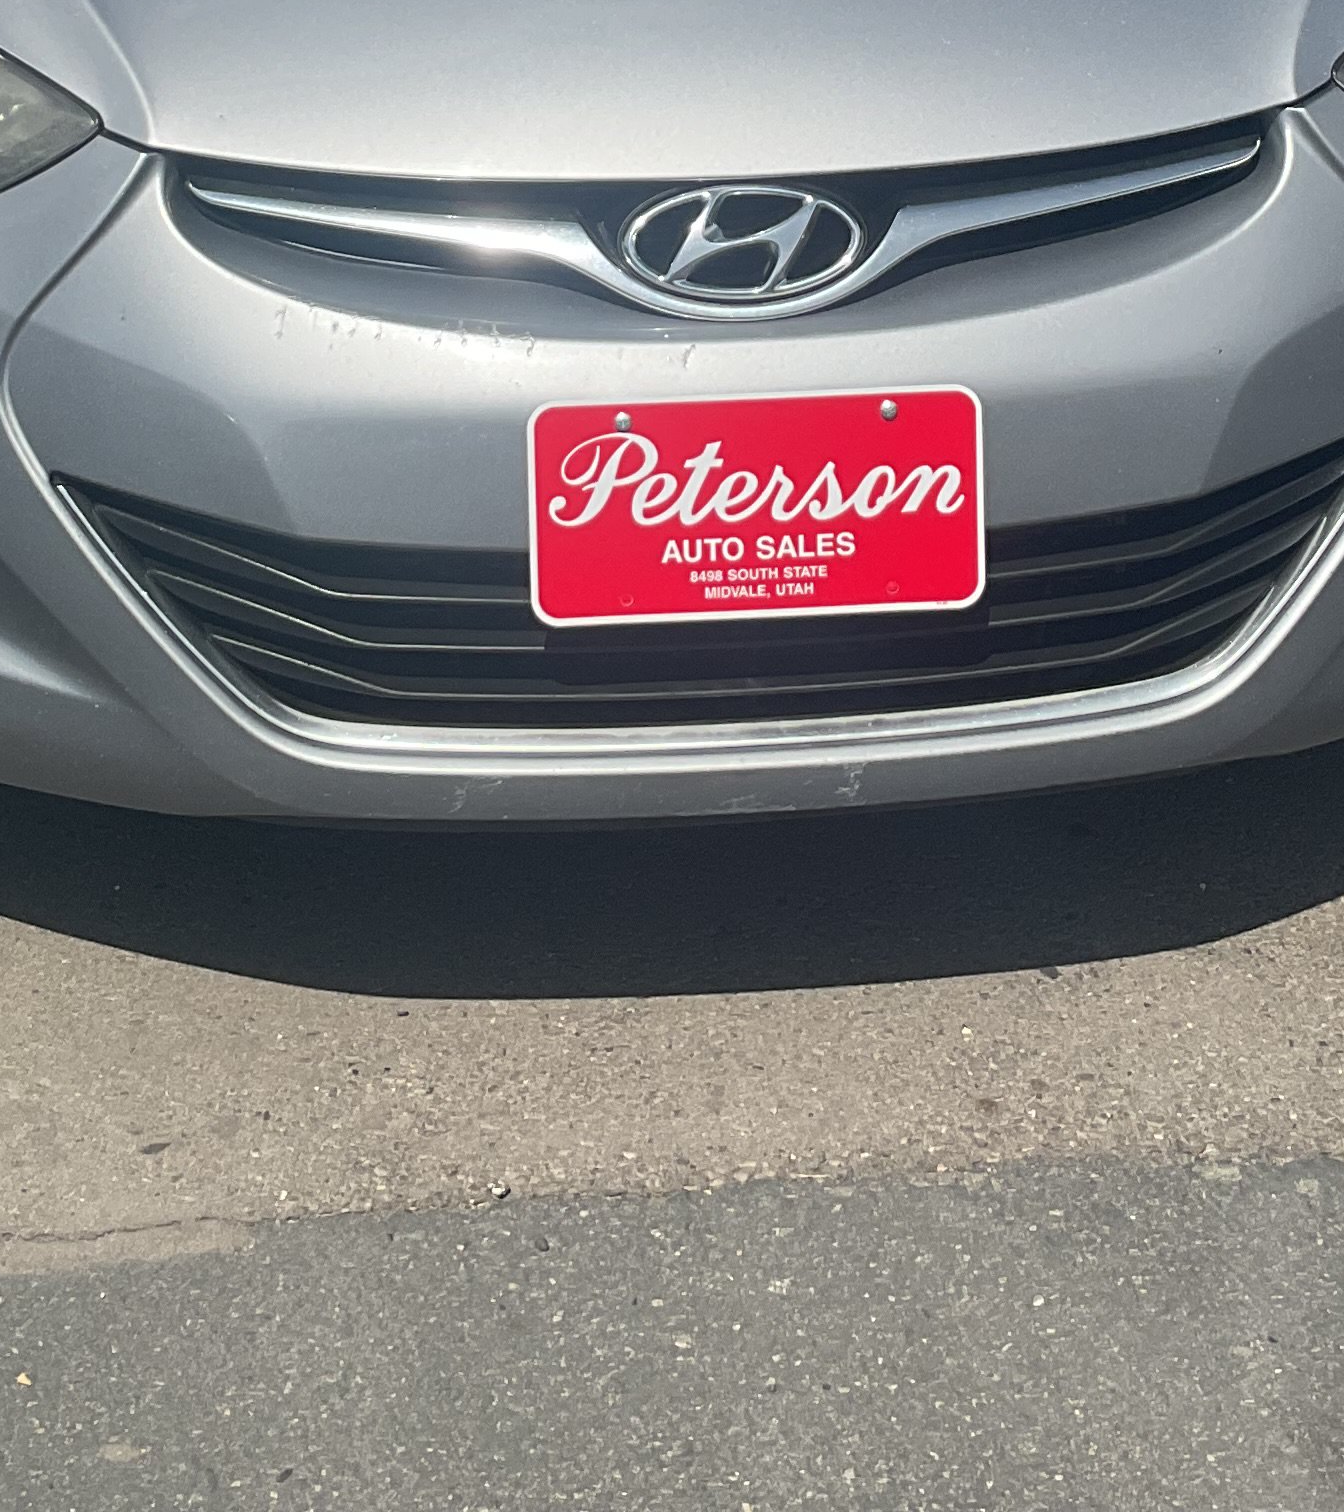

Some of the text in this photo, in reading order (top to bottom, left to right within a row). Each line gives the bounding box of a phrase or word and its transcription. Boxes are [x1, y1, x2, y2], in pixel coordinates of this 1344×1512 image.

[549, 431, 965, 528] Peterson
[661, 532, 856, 565] AUTO SALES
[689, 565, 828, 584] 8498 SOUTH STATE
[704, 582, 815, 600] MIDVALE, UTAH
